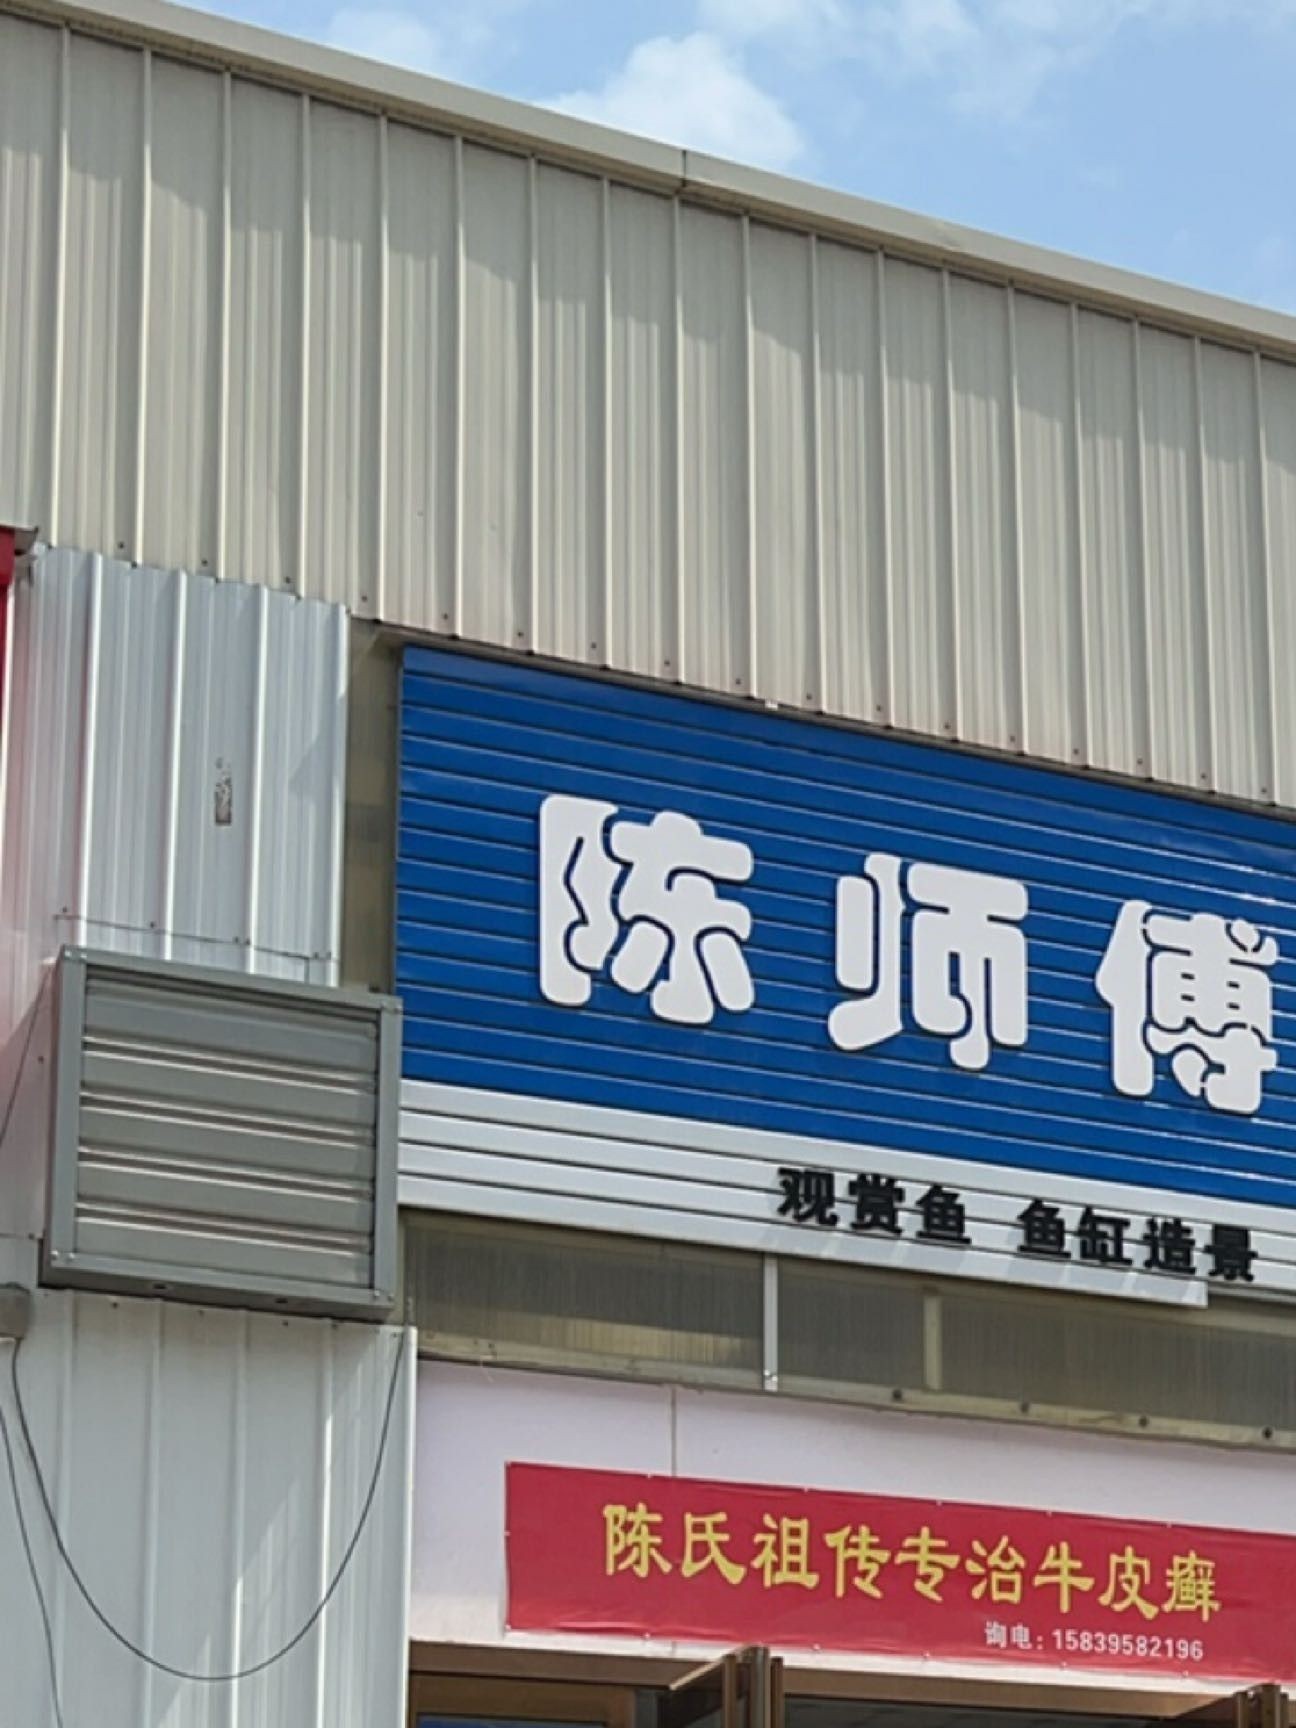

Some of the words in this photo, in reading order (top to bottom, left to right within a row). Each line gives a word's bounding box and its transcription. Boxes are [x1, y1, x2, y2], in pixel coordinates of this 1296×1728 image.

[778, 1167, 972, 1245] 观赏鱼
[1017, 1198, 1259, 1283] 鱼缸造景
[603, 1502, 1222, 1622] 陈氏祖传专治牛皮癣
